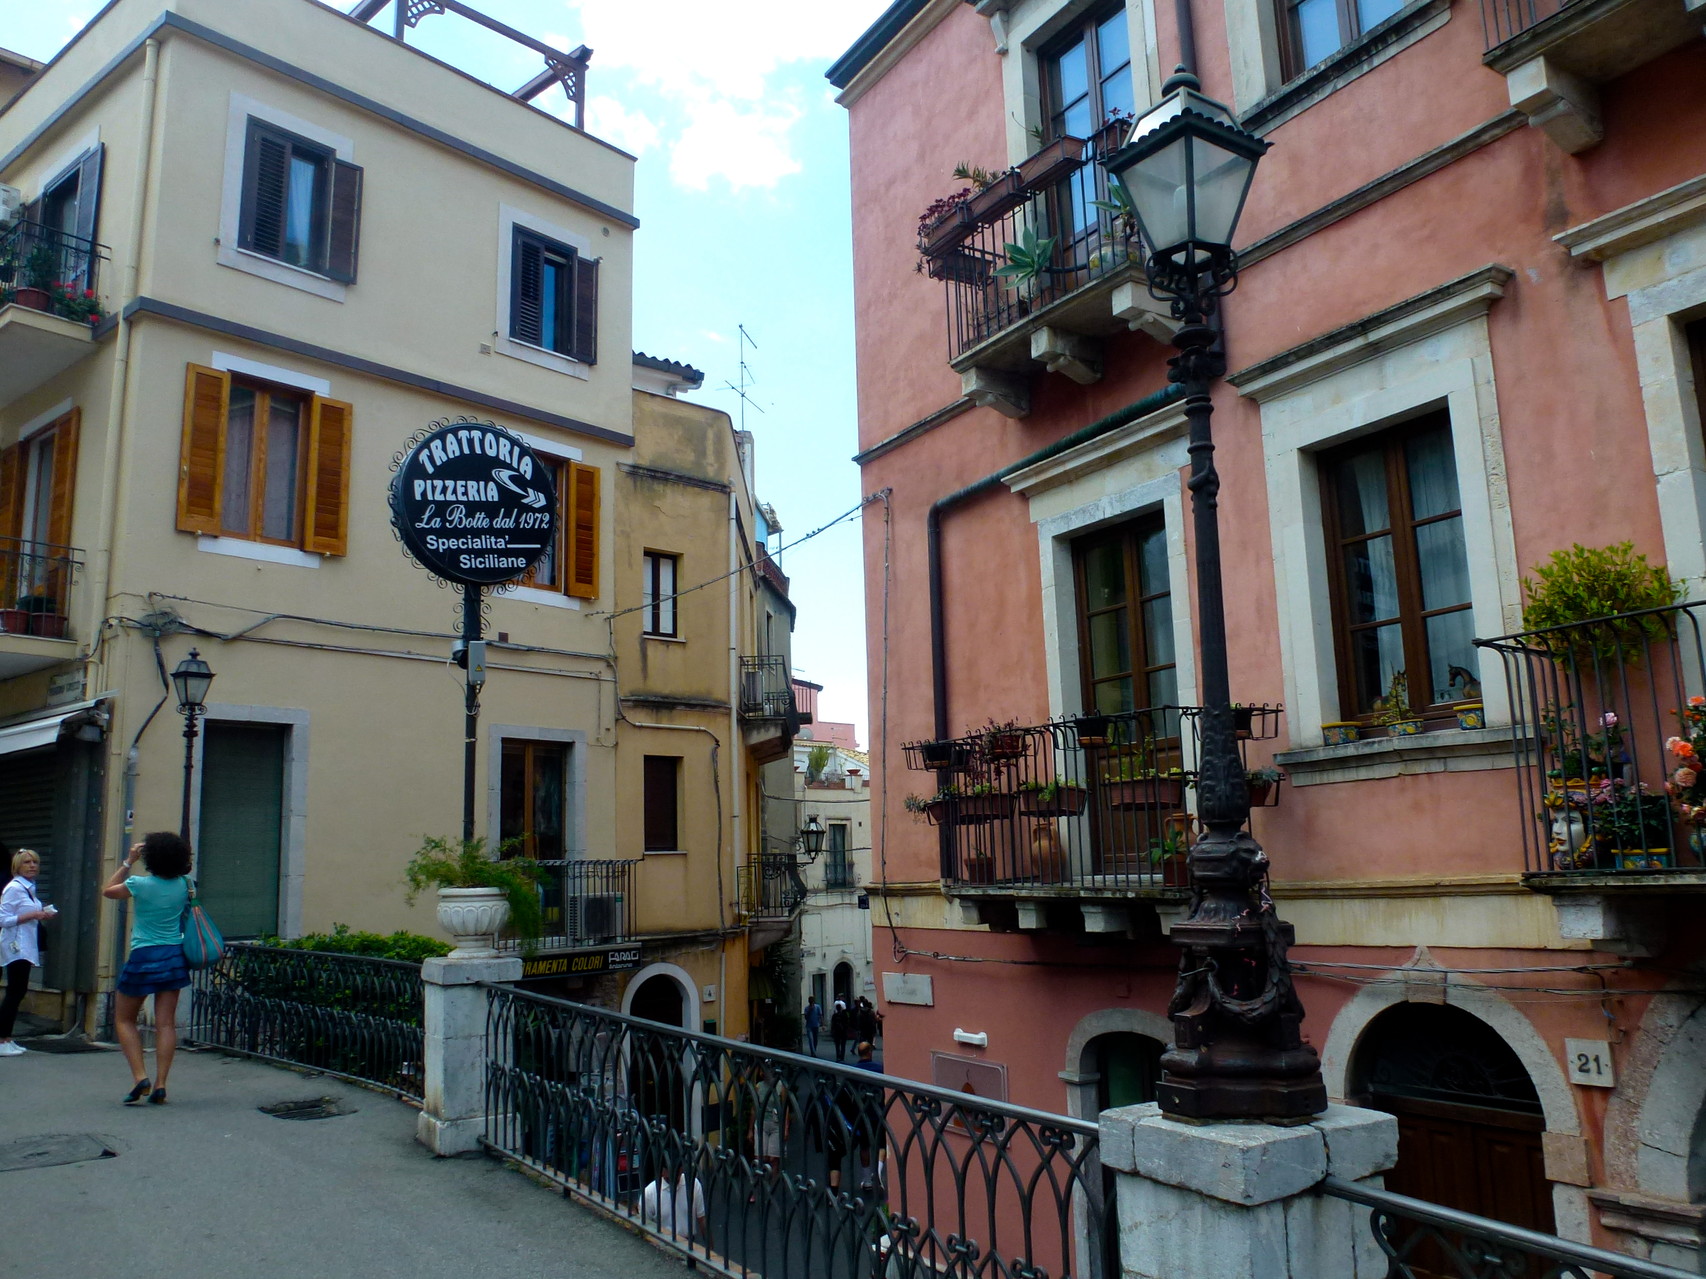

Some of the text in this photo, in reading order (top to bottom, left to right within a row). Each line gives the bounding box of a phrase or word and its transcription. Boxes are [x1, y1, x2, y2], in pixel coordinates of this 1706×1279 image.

[418, 429, 533, 481] TRATTORIA
[413, 479, 499, 502] PIZZERIA
[415, 504, 550, 529] La Botte dal 1972
[426, 535, 509, 552] Specialita'
[459, 554, 527, 569] Siciliane
[571, 955, 603, 972] COLORI
[1577, 1053, 1602, 1075] 21
